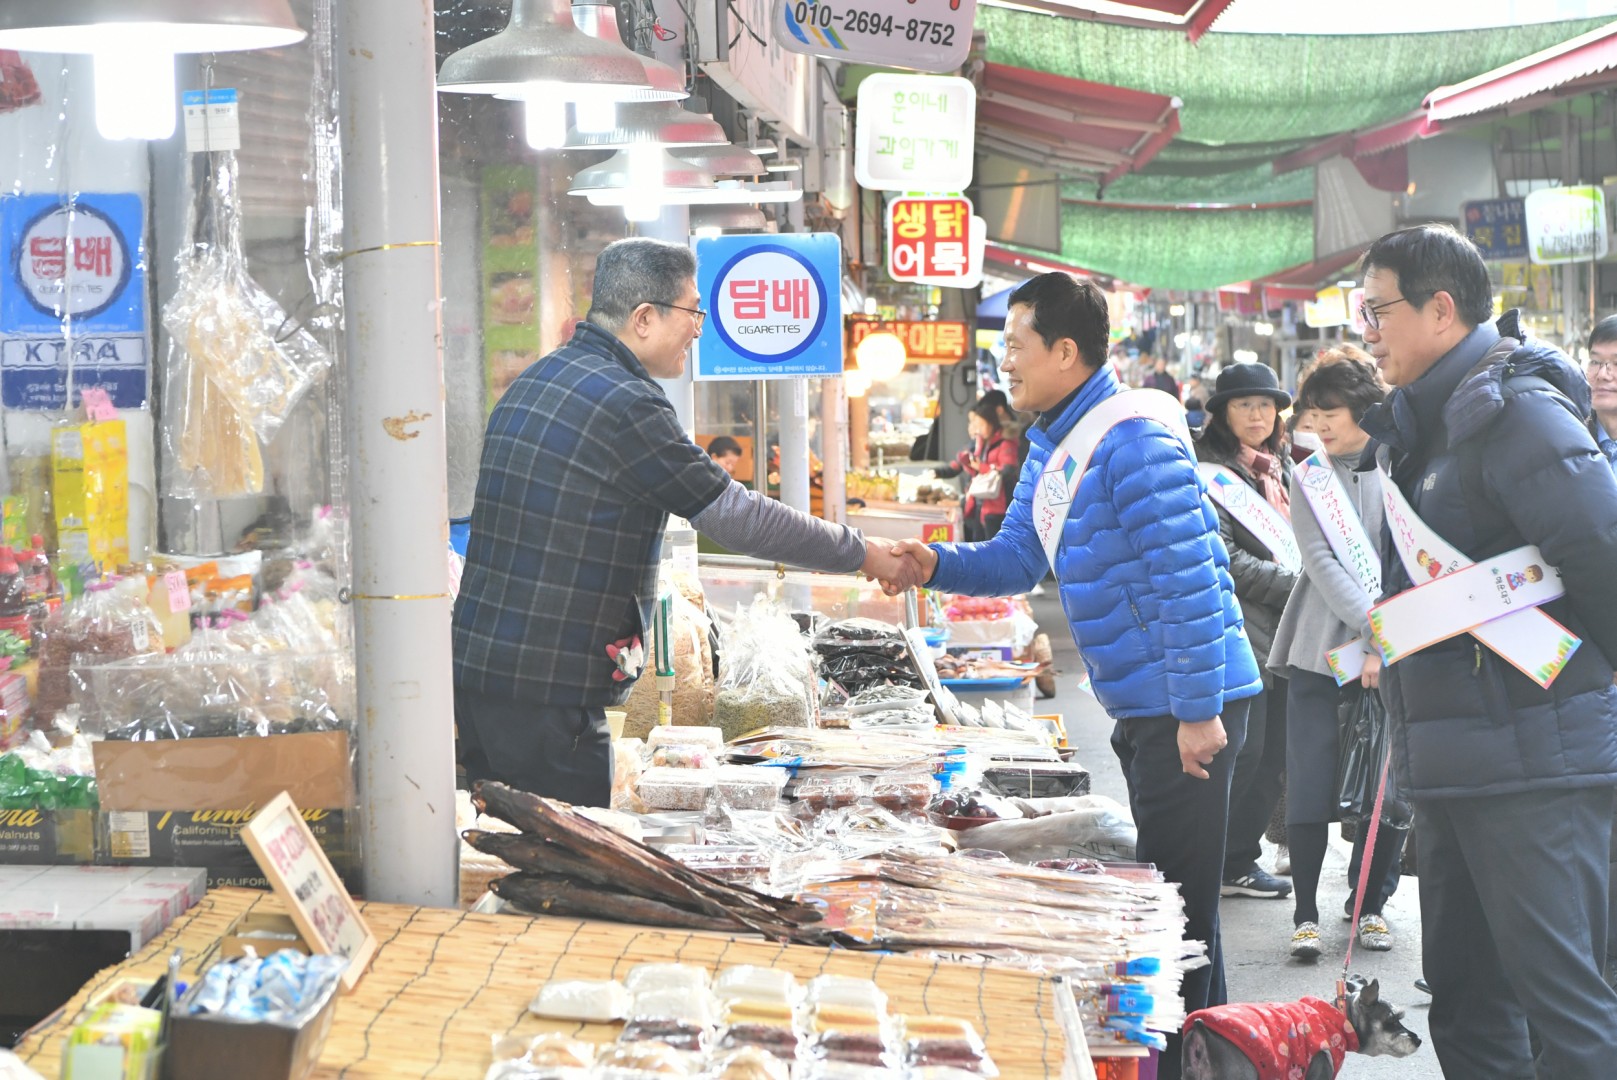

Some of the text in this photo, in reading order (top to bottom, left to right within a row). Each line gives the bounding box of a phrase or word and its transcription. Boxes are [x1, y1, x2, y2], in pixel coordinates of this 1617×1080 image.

[794, 2, 955, 46] 010-2694-8752
[876, 135, 959, 170] 과일가게
[893, 202, 967, 239] 생닭
[893, 241, 967, 277] 어묵
[729, 278, 810, 320] 담배
[737, 324, 801, 335] CIGARETTES
[173, 824, 231, 836] California
